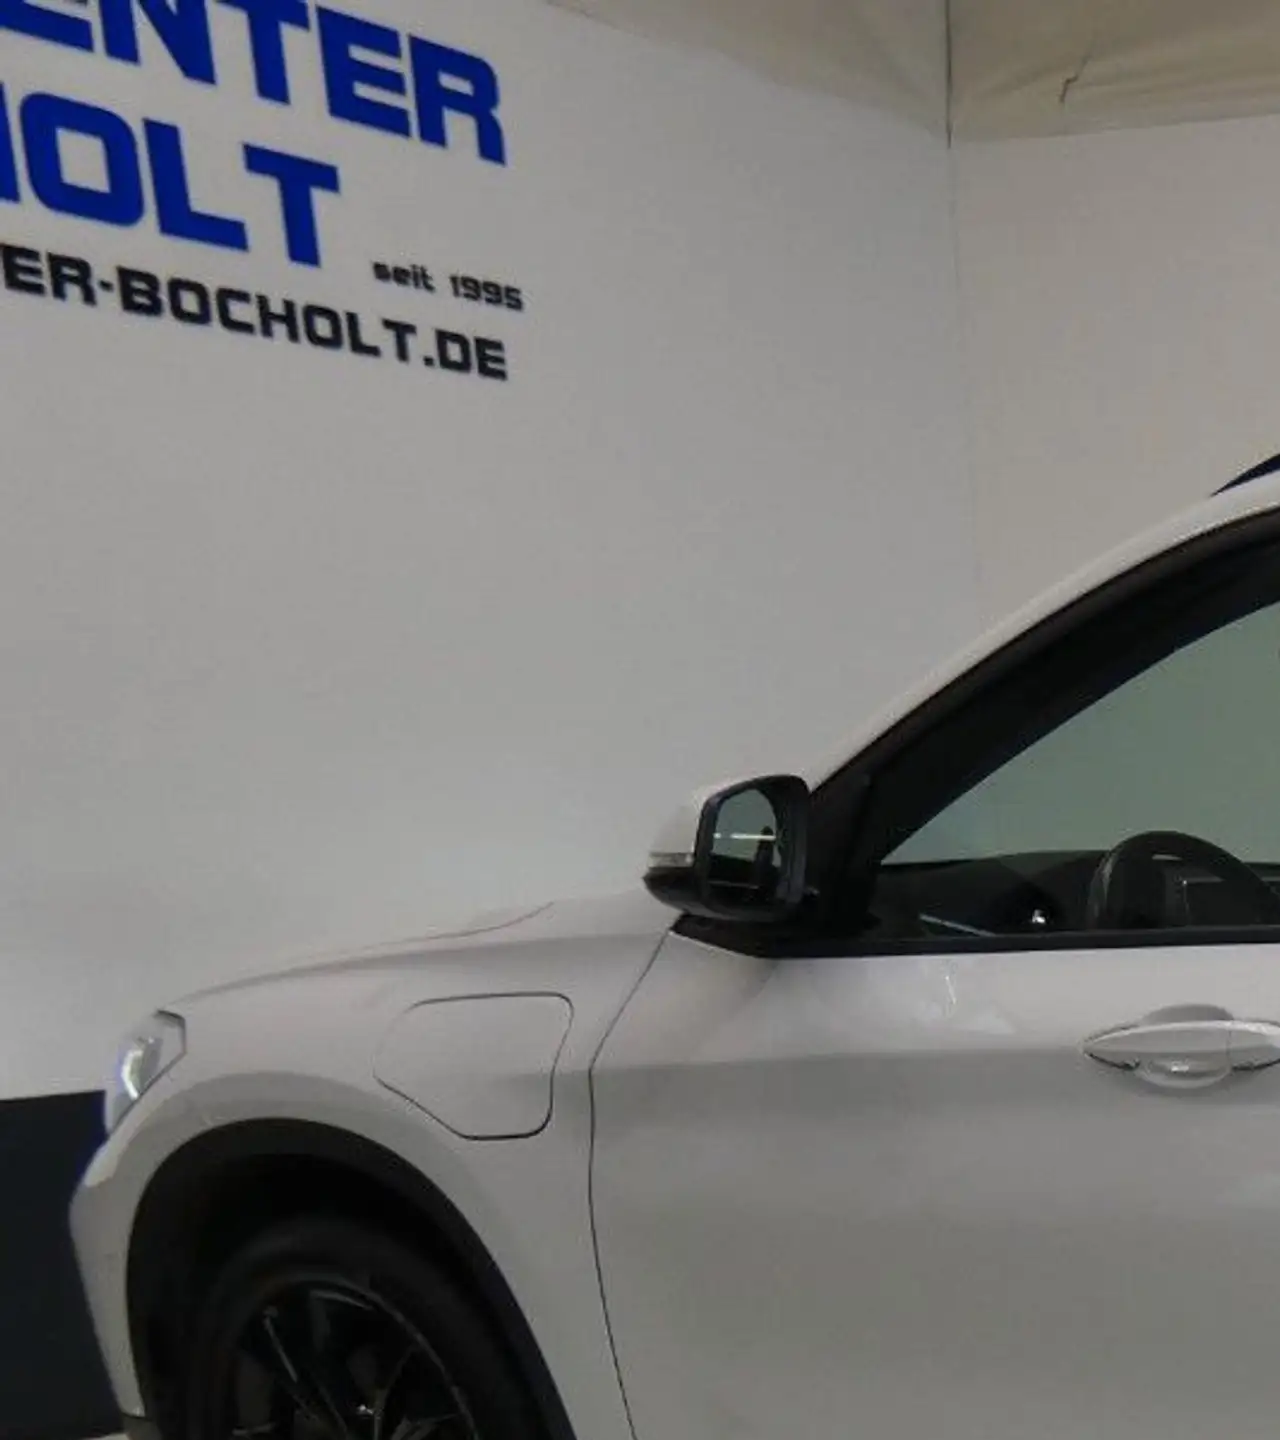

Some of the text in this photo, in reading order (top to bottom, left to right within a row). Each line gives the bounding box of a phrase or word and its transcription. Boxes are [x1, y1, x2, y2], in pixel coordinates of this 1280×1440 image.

[0, 86, 340, 268] OLT
[0, 243, 508, 381] ER-BOCHOLT.DE
[372, 261, 523, 311] seit 1995
